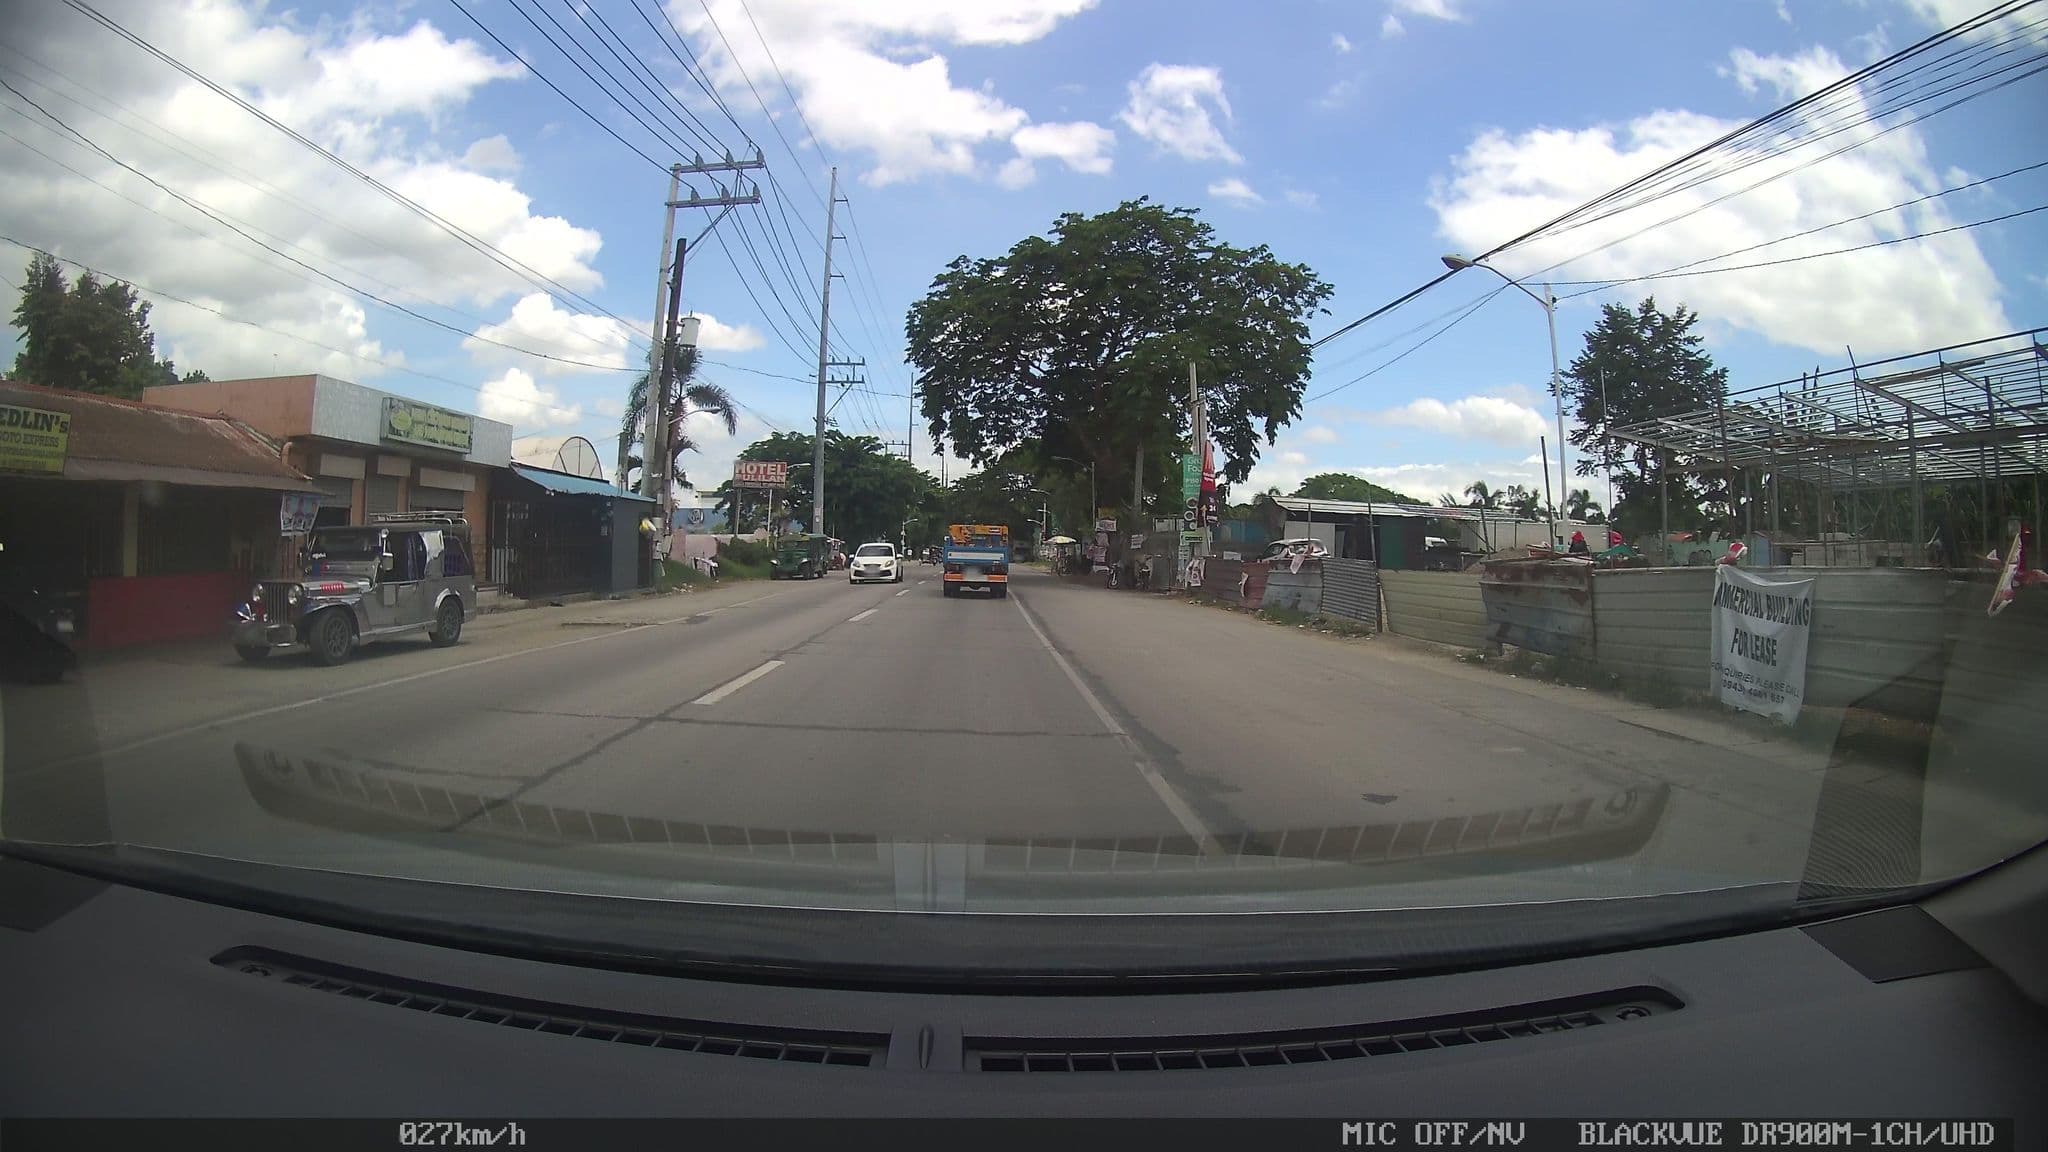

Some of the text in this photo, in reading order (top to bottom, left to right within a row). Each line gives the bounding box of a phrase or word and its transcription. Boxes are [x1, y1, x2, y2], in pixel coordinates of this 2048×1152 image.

[0, 431, 59, 448] OTO EXPRESS
[1766, 594, 1811, 627] BUILDING
[1731, 628, 1778, 667] FOR LEASE
